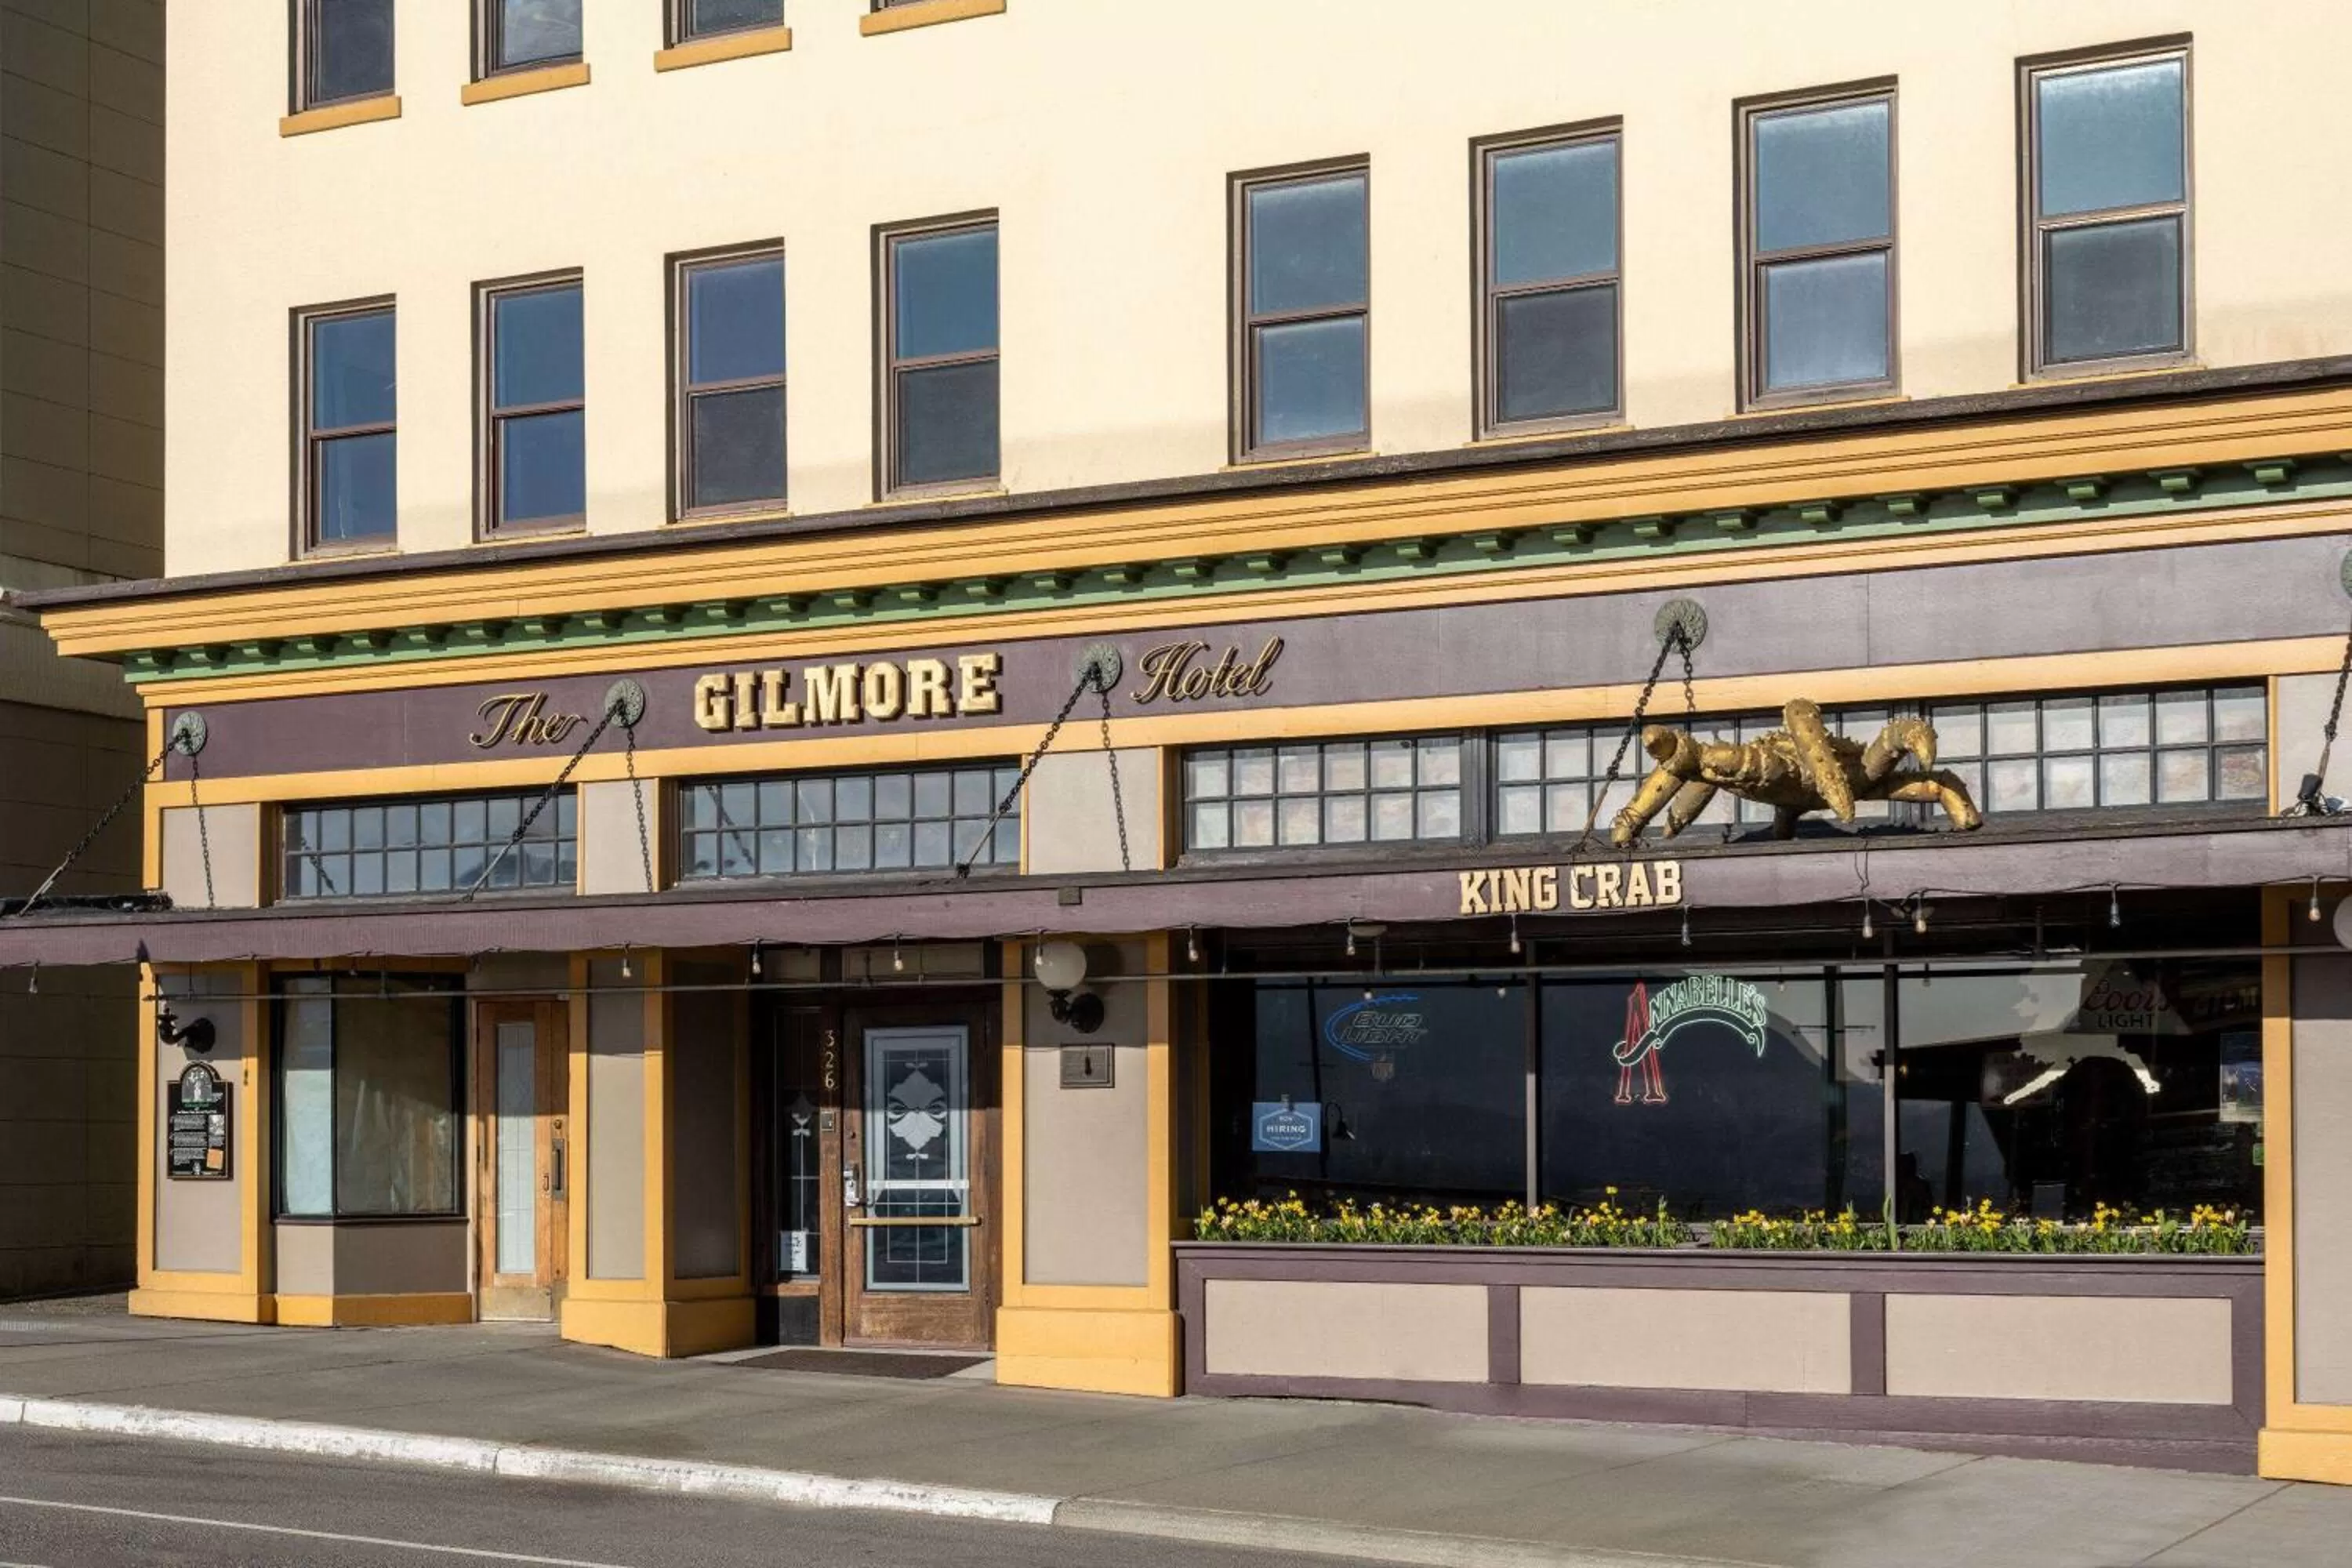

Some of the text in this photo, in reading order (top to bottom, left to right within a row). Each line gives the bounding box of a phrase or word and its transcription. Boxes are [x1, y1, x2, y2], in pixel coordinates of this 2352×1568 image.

[470, 636, 1283, 748] The GILMORE Hotel
[1458, 860, 1682, 915] KING CRAB
[1352, 1011, 1422, 1028] BUD
[2096, 1013, 2156, 1029] LIGHT
[825, 1029, 835, 1089] 326
[1266, 1124, 1307, 1134] HIRING
